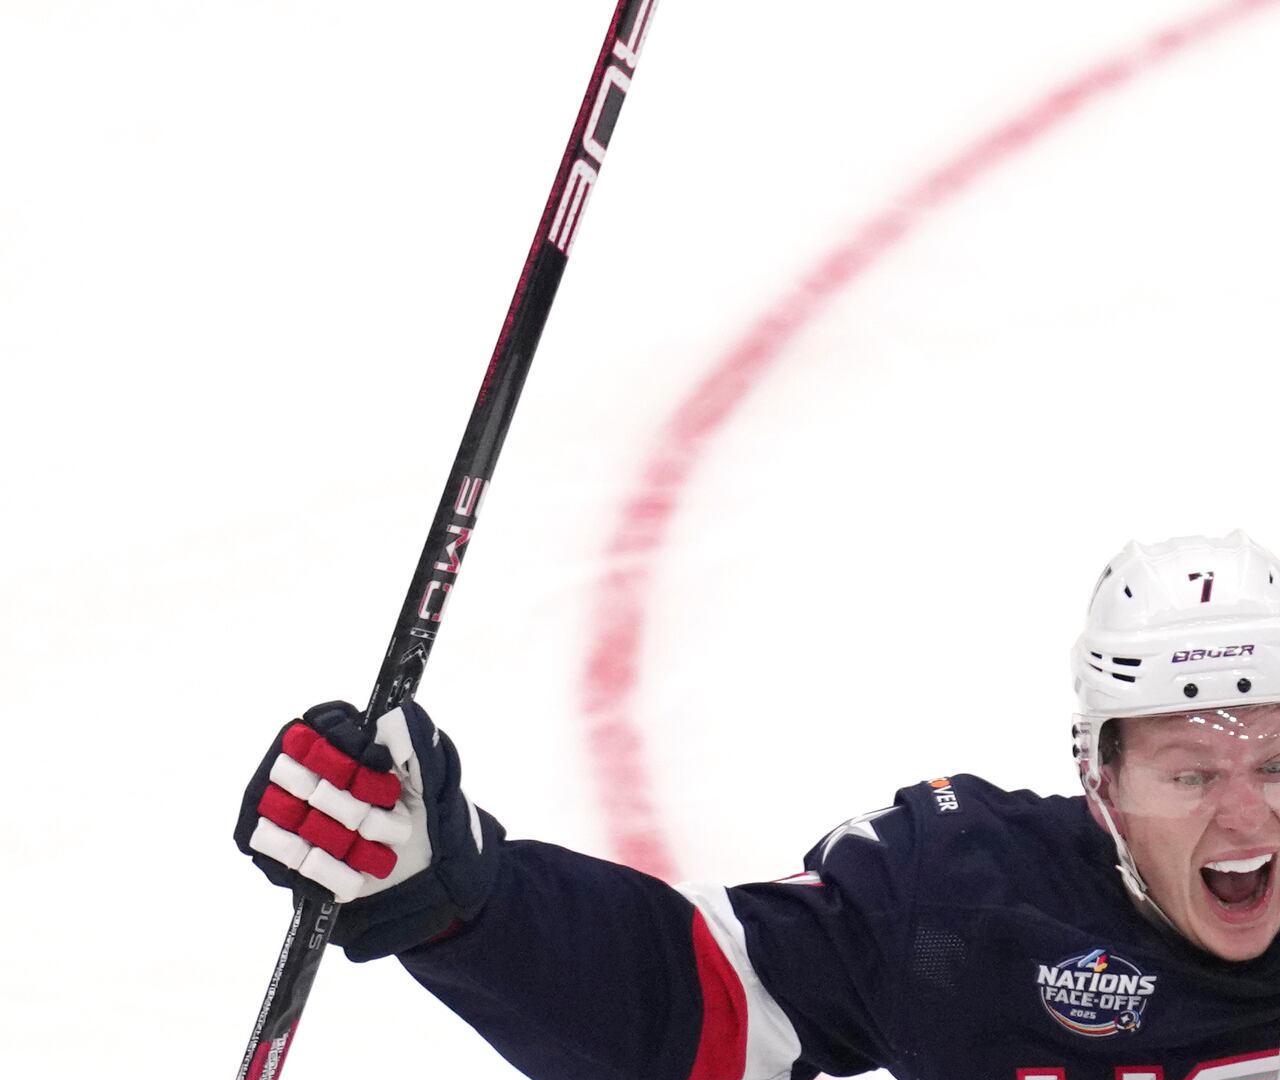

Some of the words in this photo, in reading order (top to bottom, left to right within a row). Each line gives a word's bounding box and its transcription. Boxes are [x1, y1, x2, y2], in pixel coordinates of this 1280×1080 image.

[1188, 571, 1215, 604] 7
[1171, 644, 1256, 664] BAUER
[1037, 964, 1158, 996] NATIONS
[1045, 985, 1142, 1012] FACE-OFF
[1069, 1007, 1097, 1020] 2025
